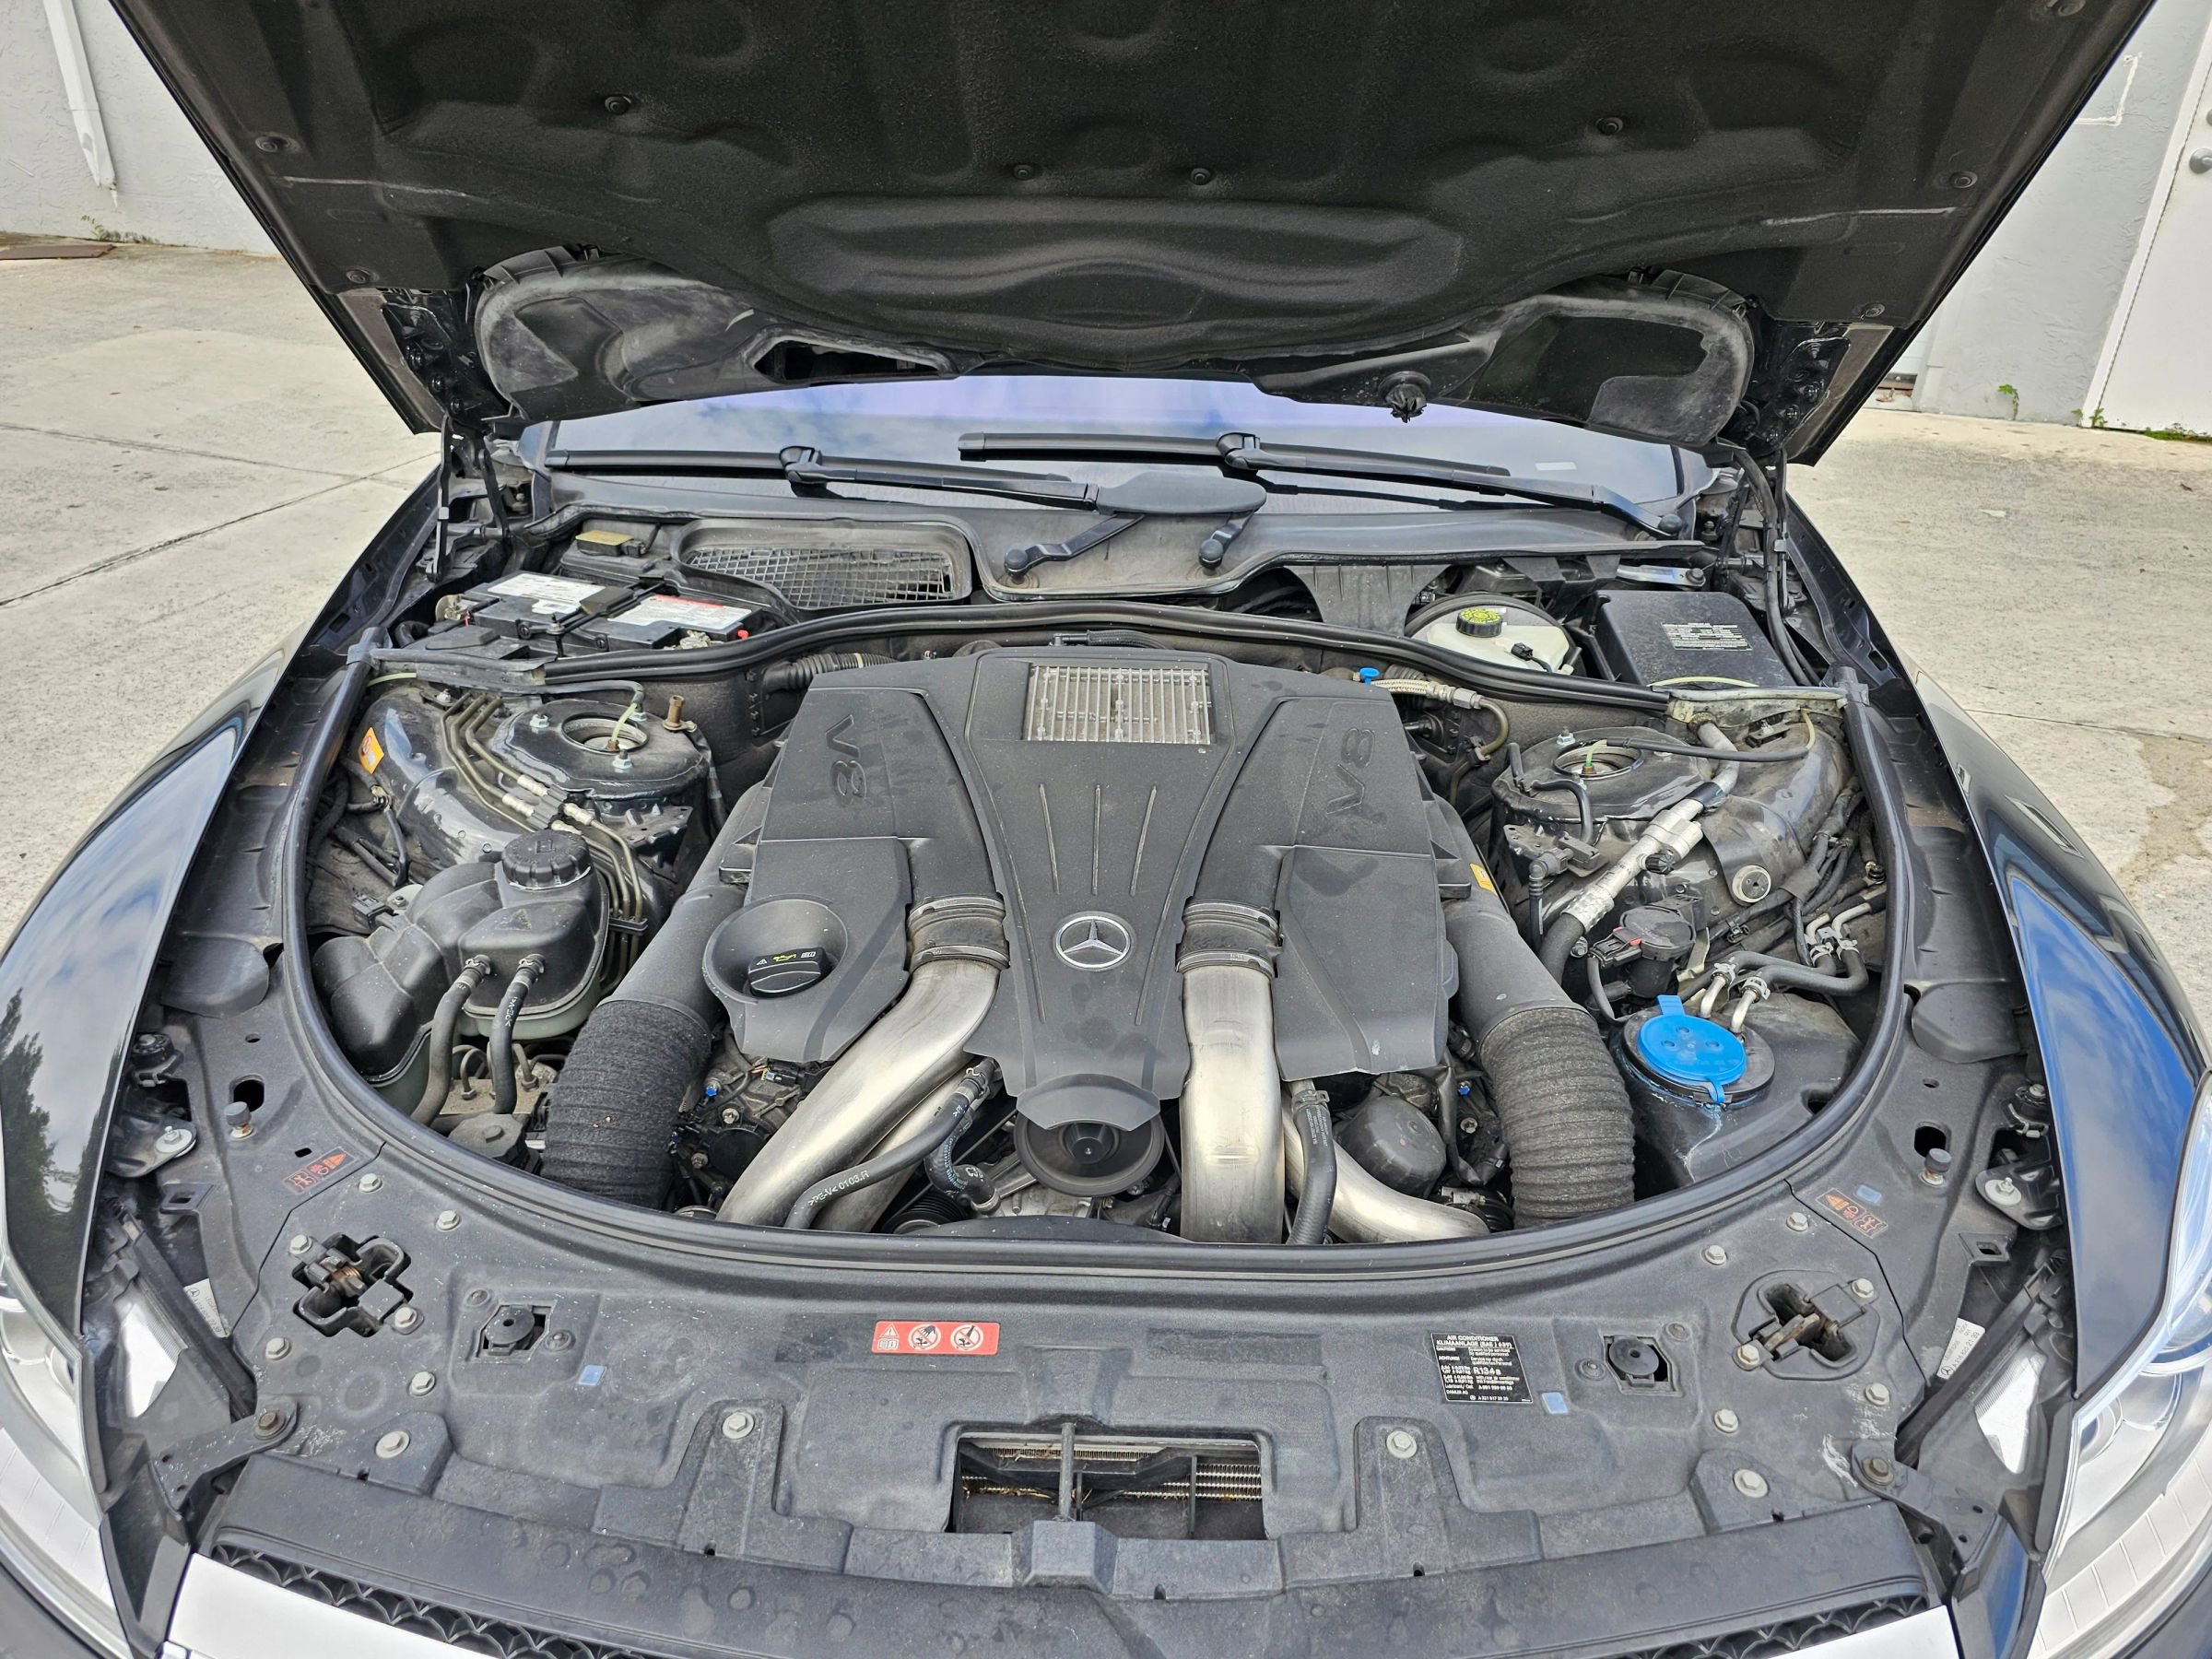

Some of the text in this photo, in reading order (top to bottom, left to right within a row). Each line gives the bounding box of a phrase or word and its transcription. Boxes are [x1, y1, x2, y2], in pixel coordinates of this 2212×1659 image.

[824, 714, 867, 799] V8
[1327, 726, 1376, 815] V8
[808, 1170, 869, 1206] >PE-V< 0103.R
